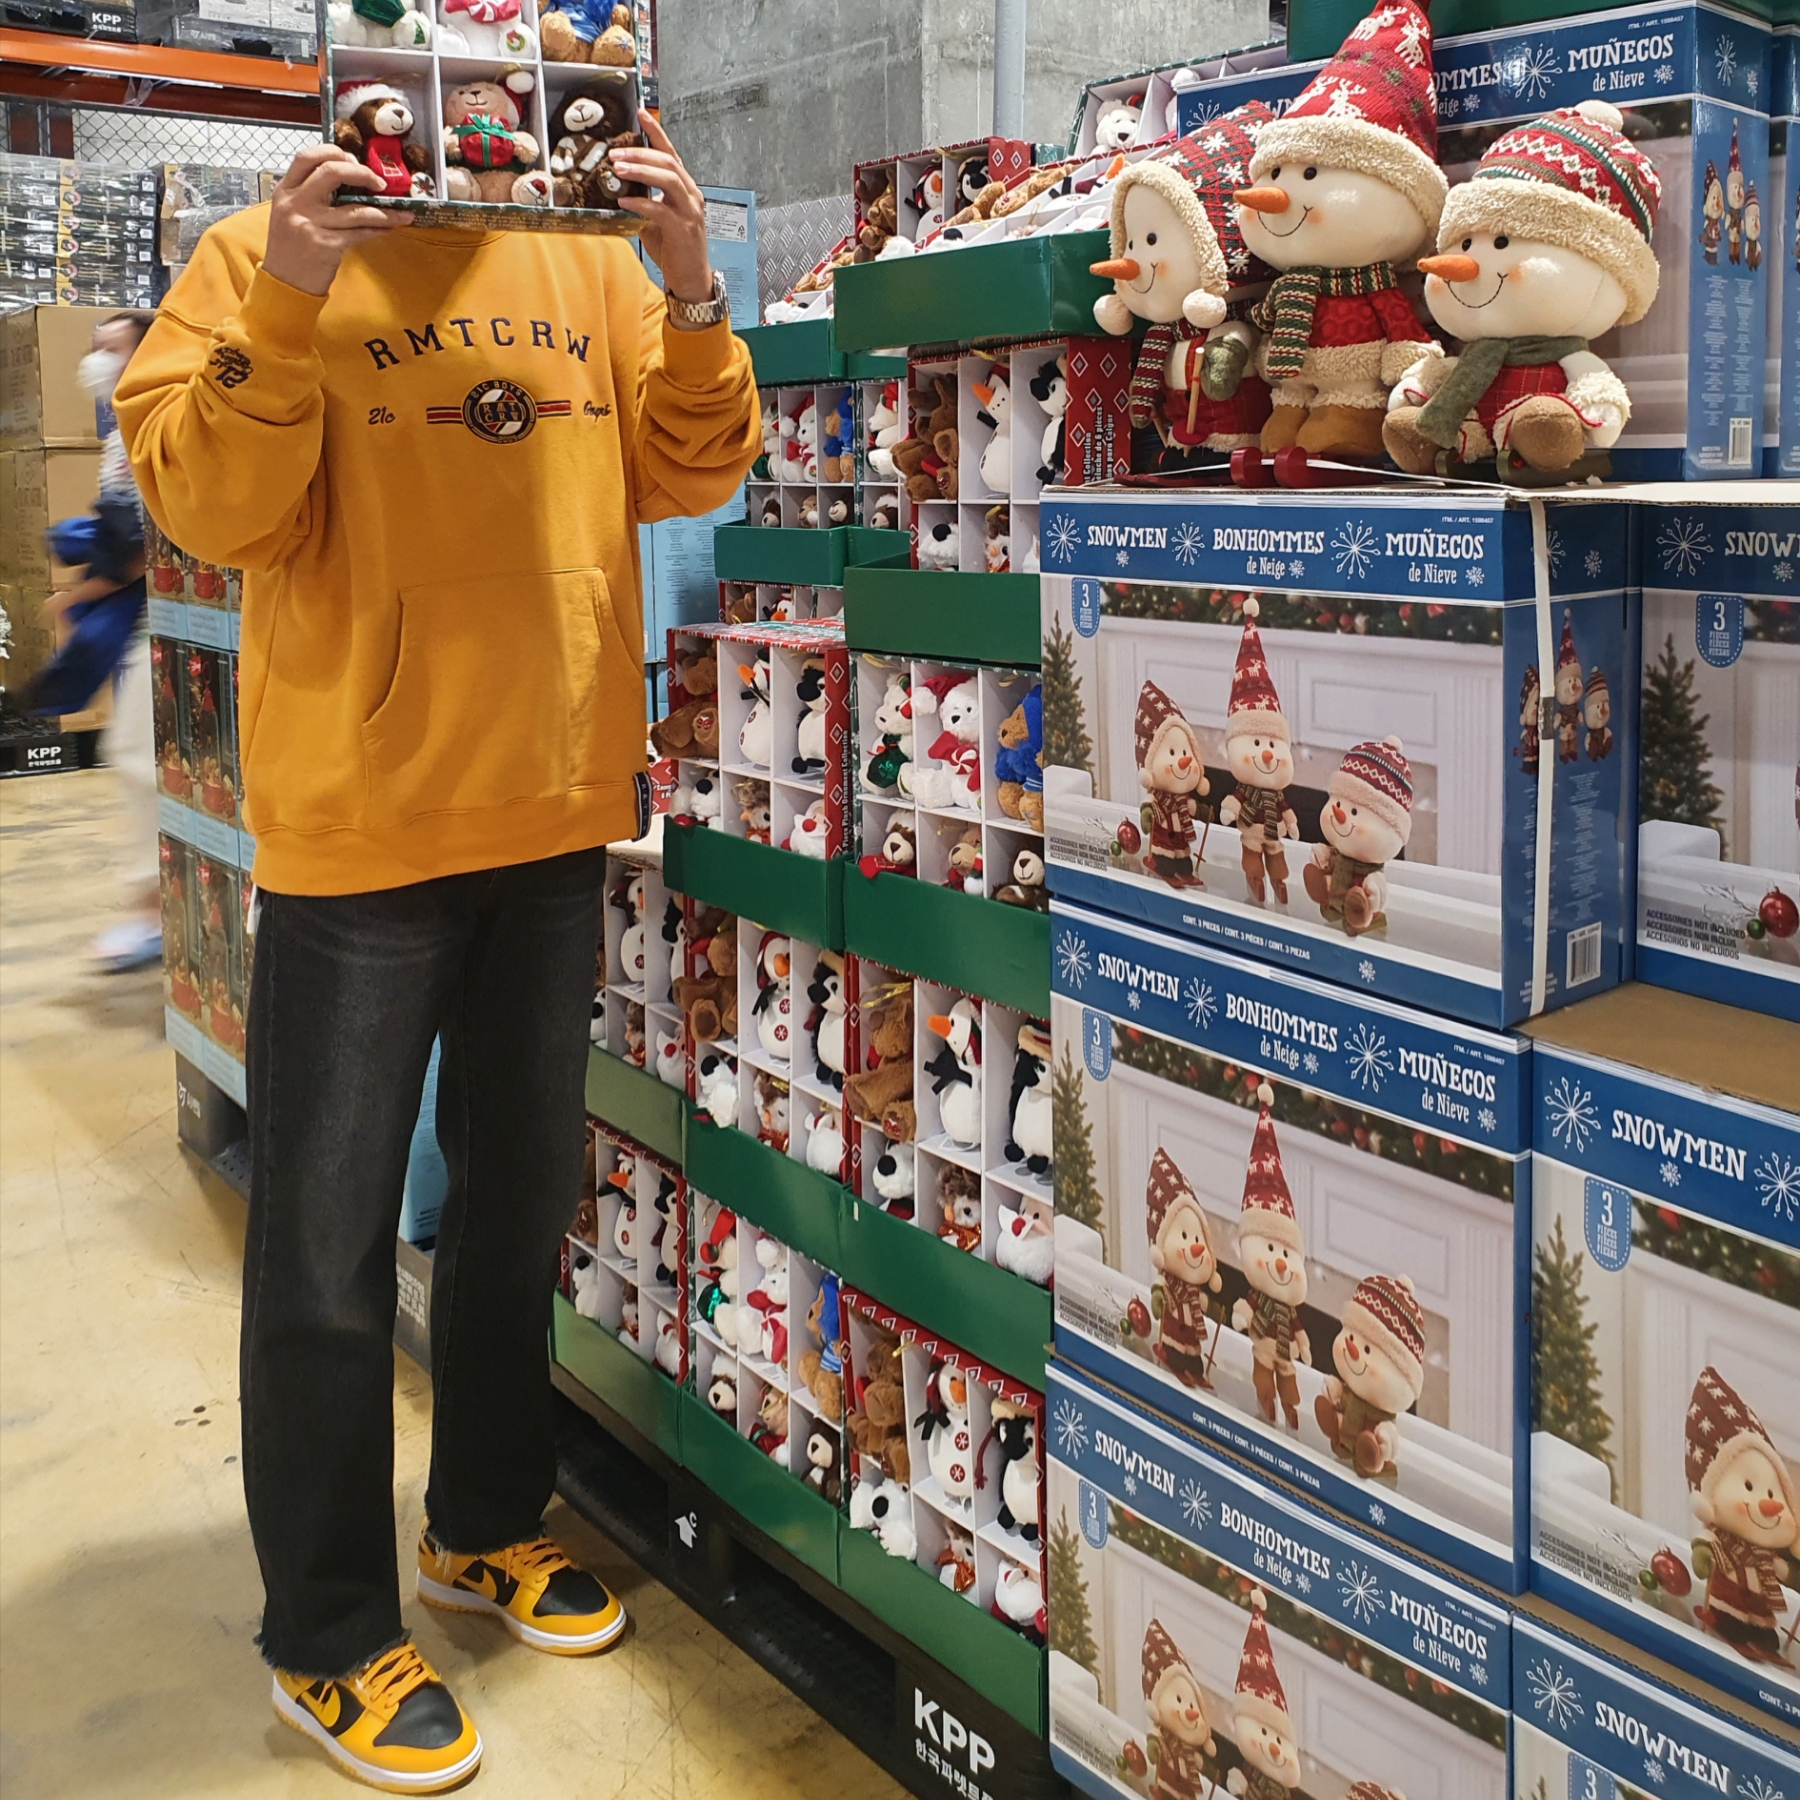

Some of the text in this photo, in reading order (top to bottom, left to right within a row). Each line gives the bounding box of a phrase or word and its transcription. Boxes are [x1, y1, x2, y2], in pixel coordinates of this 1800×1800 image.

[92, 12, 122, 25] KPP
[1568, 33, 1674, 72] MUÑECOS
[1592, 76, 1606, 92] de
[1609, 70, 1645, 90] Nieve
[364, 316, 591, 370] RMTCRW
[494, 380, 522, 396] BOYS
[1095, 406, 1104, 433] pièces
[1106, 414, 1114, 442] Colgar
[1084, 432, 1092, 475] Collection
[1095, 442, 1102, 452] de
[1106, 443, 1114, 462] para
[1094, 453, 1102, 481] eluche
[1087, 526, 1484, 560] SNOWMEN BONHOMMES MUÑECOS
[1724, 531, 1800, 558] SNOW
[1246, 557, 1458, 584] de Neige de Nieve
[1082, 583, 1090, 608] 3
[1714, 601, 1726, 630] 3
[28, 746, 62, 760] KPP
[1183, 914, 1198, 926] CONT.
[1203, 920, 1220, 933] PIECES
[1225, 926, 1240, 938] CONT.
[1240, 932, 1244, 940] 3
[1268, 940, 1284, 952] CONT.
[1285, 945, 1290, 953] 3
[1290, 946, 1310, 960] PIEZAS
[1646, 909, 1746, 939] ACCESSORIES NOT INCLUDED
[1646, 920, 1736, 948] ACCESSOIRES NON INCLUS
[1646, 930, 1740, 960] ACCESORIOS NO INCLUIDOS
[1093, 1017, 1100, 1046] 3
[1098, 952, 1496, 1103] SNOWMEN BONHOMMES MUÑECOS
[1260, 1036, 1470, 1124] de Neige de Nieve
[1612, 1109, 1747, 1182] SNOWMEN
[1602, 1190, 1613, 1227] 3
[1193, 1412, 1208, 1426] CONT.
[1235, 1435, 1250, 1450] CONT.
[1278, 1459, 1294, 1475] CONT.
[1300, 1470, 1320, 1489] PIEZAS
[1090, 1492, 1096, 1519] 3
[1094, 1430, 1488, 1661] SNOWMEN BONHOMMES MUÑECOS
[1587, 1554, 1600, 1566] NOT
[1584, 1572, 1593, 1582] NO
[1587, 1564, 1602, 1578] NON
[1253, 1546, 1461, 1672] de Neige de Nieve
[1758, 1690, 1783, 1710] CONT.
[1784, 1702, 1790, 1712] 3
[914, 1687, 995, 1774] KPP
[1594, 1701, 1730, 1793] SNOWMEN
[1586, 1768, 1597, 1800] 3
